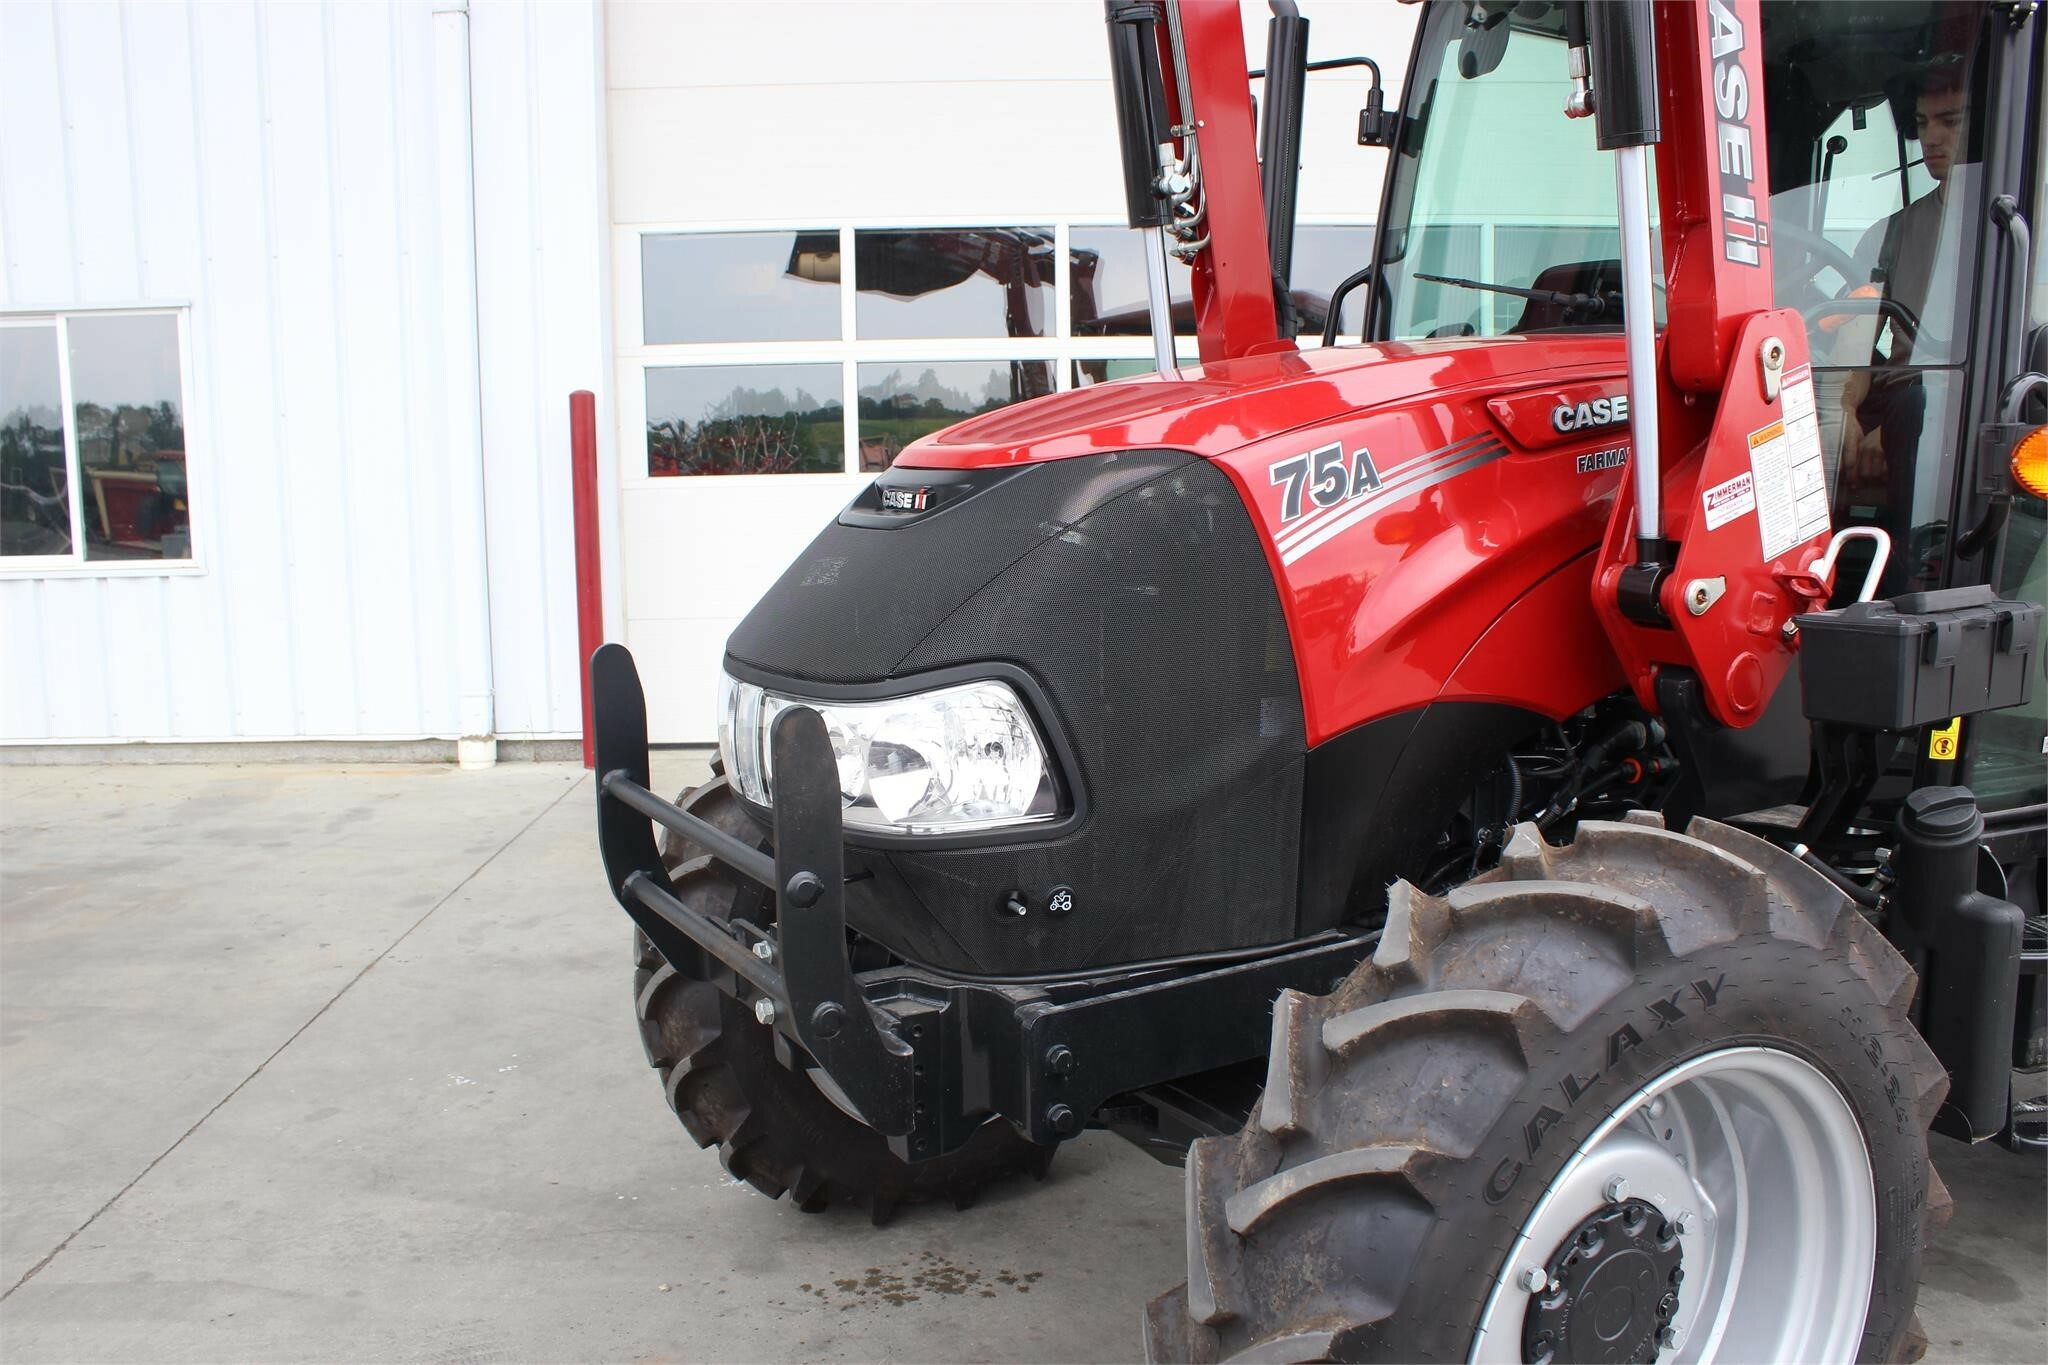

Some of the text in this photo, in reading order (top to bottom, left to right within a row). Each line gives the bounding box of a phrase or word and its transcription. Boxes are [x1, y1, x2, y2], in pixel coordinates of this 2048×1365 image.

[1708, 0, 1753, 181] ASE
[1553, 395, 1628, 432] CASE
[881, 489, 912, 509] CASE
[1268, 440, 1383, 523] 75A
[1707, 475, 1751, 511] ZIMMERMAN
[1482, 972, 1726, 1206] GALAXY
